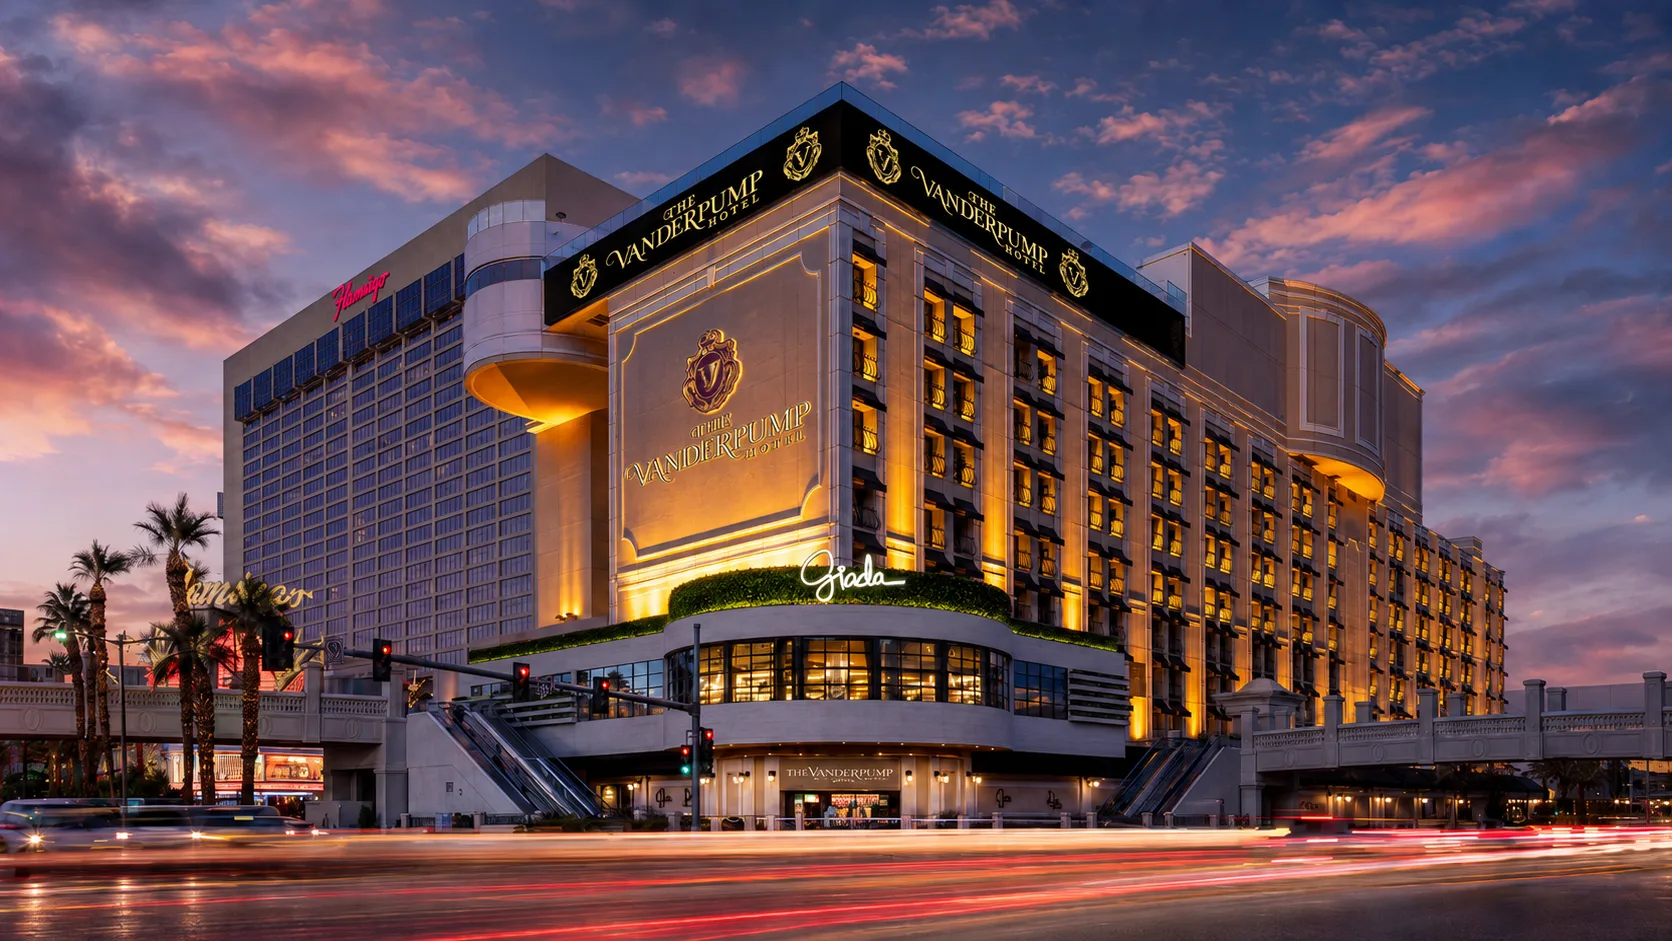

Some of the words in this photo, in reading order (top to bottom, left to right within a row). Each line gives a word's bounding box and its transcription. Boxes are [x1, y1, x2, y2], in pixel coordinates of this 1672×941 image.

[663, 194, 696, 220] THE
[708, 197, 760, 228] HOTEL
[910, 165, 1048, 266] VANDERPUMP
[968, 191, 997, 215] THE
[606, 170, 763, 269] VANDERPUMP
[1005, 244, 1046, 275] HOTEL
[697, 359, 720, 392] V
[624, 401, 811, 486] VANDERPUMP
[744, 430, 806, 459] HOTEL
[801, 549, 906, 602] Giada
[786, 768, 808, 777] THE
[808, 766, 894, 780] VANDERPUMP
